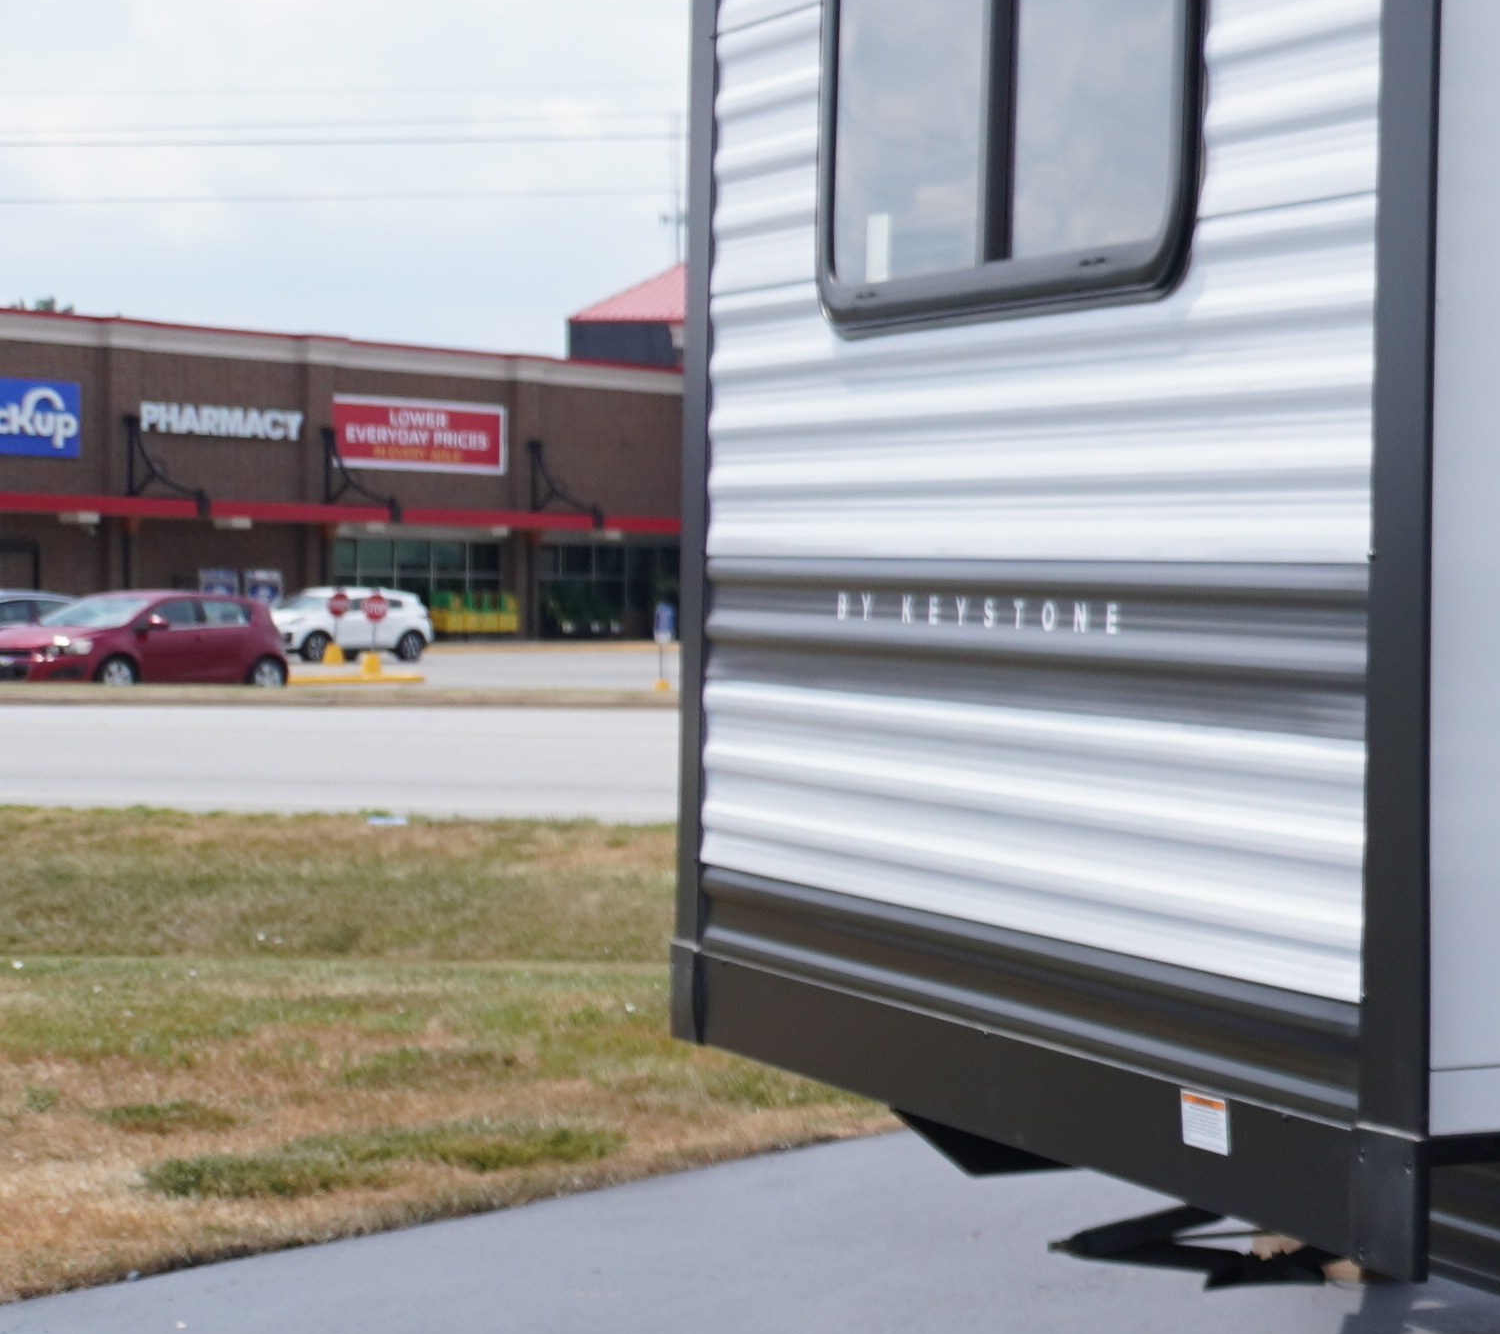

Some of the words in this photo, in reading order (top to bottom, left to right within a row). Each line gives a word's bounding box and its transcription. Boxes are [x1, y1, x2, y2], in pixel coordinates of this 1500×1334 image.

[139, 400, 304, 442] PHARMACY
[388, 407, 449, 428] LOWER
[344, 422, 430, 447] EVERYDAY
[432, 430, 490, 451] PRICES
[836, 591, 872, 622] BY
[901, 593, 1122, 635] KEYSTONE
